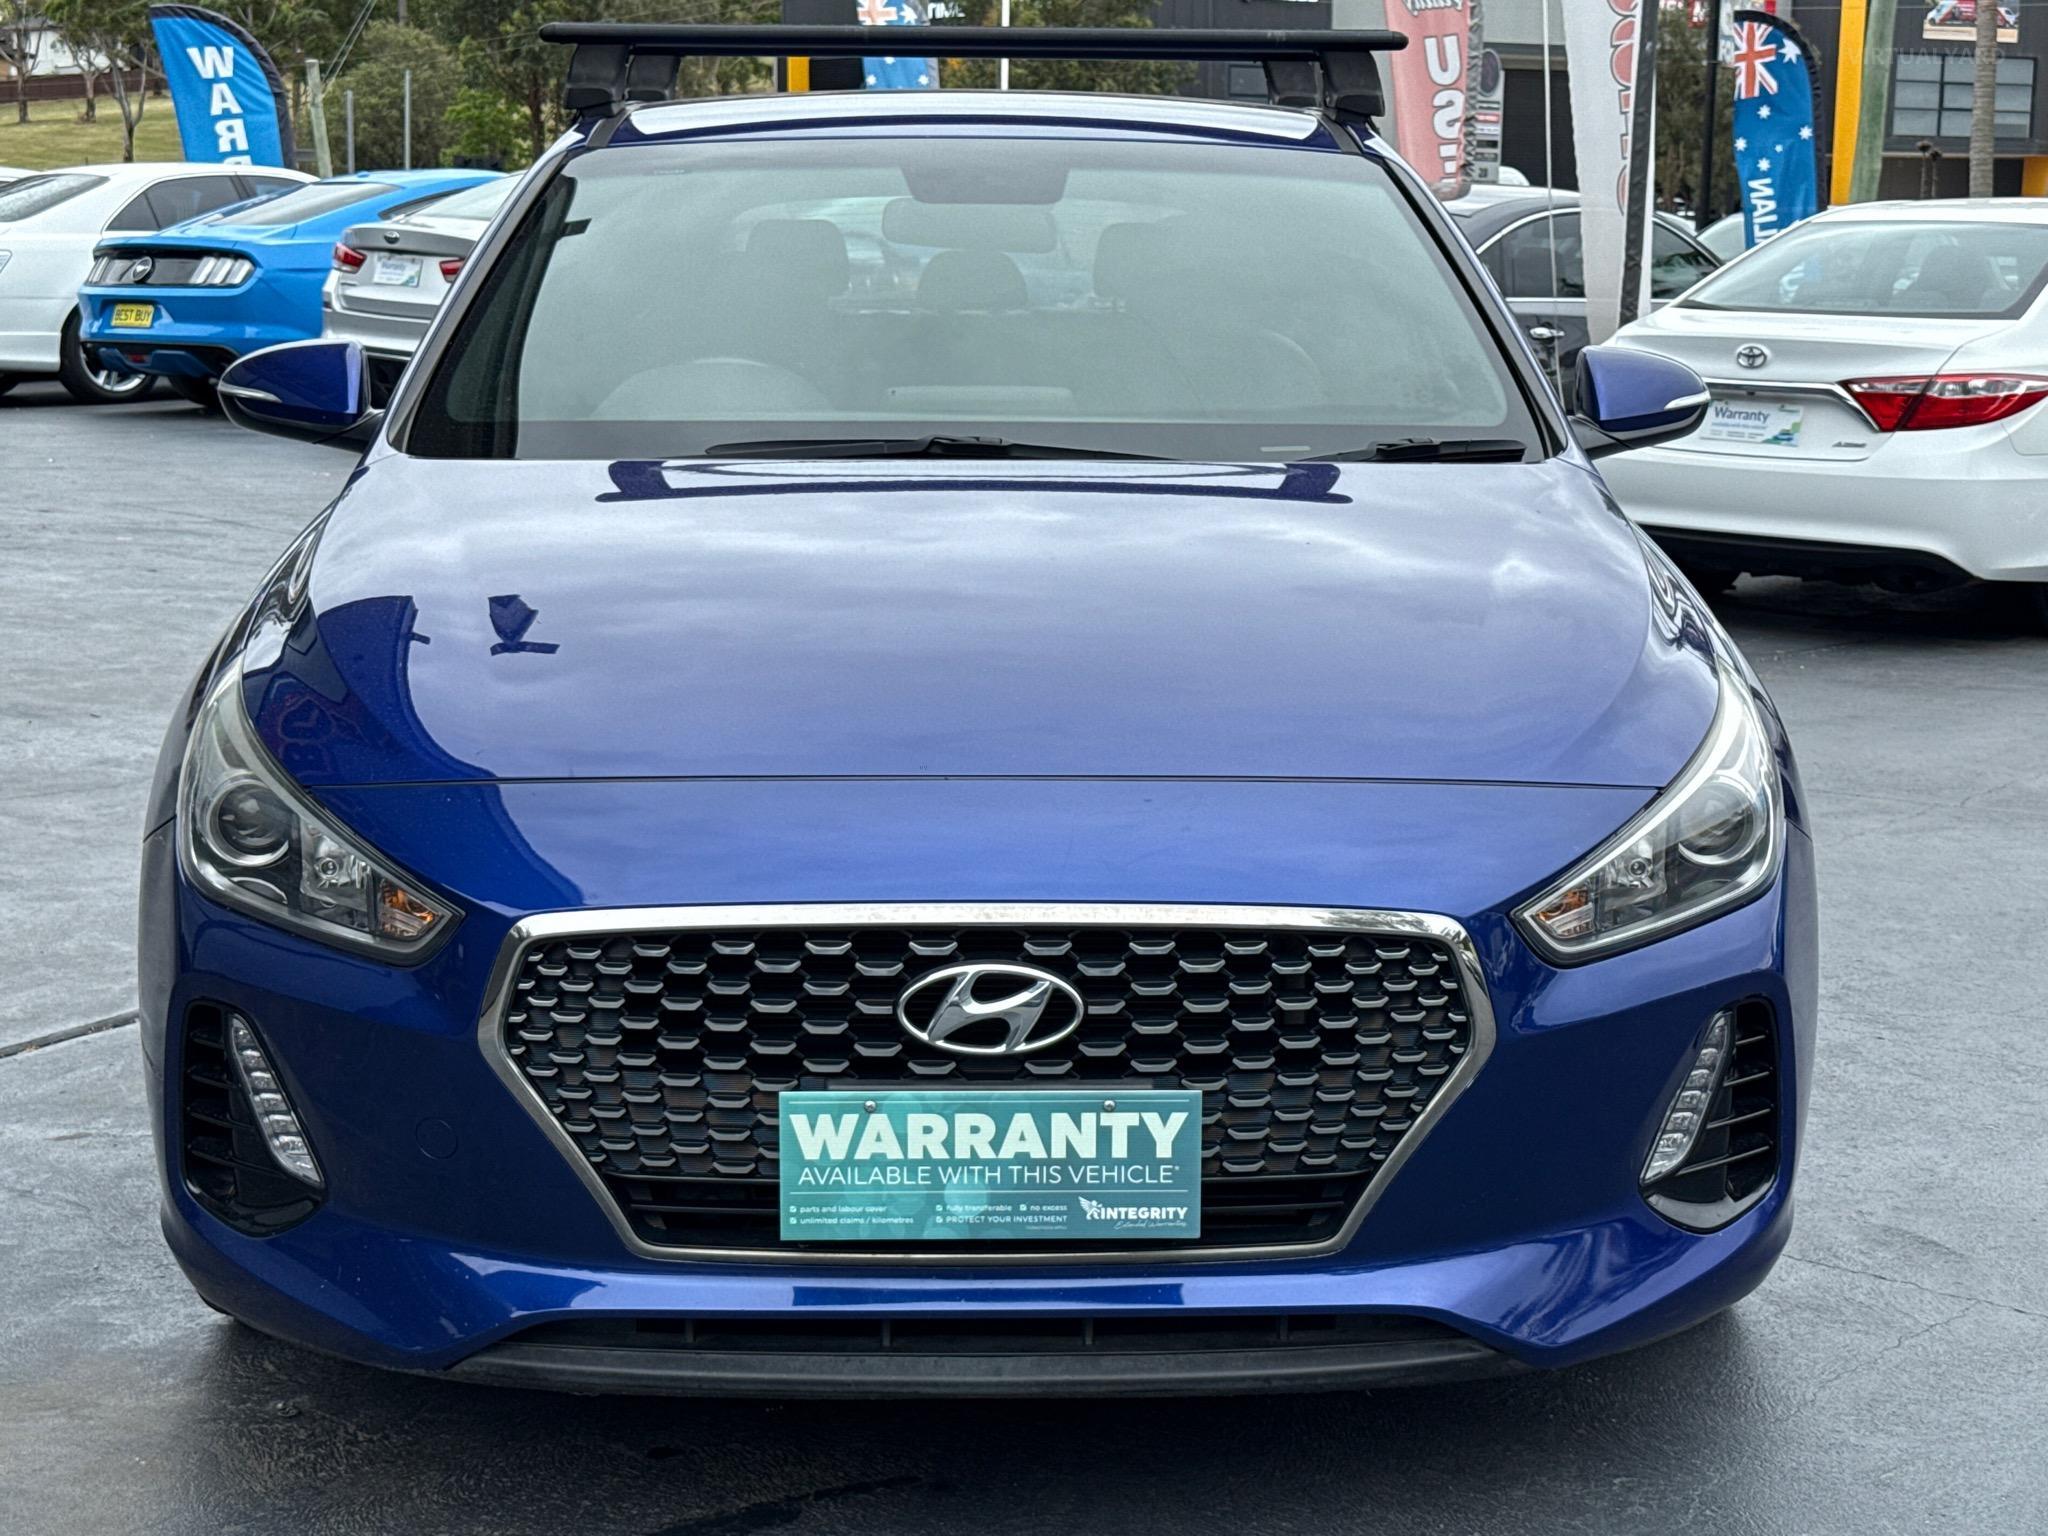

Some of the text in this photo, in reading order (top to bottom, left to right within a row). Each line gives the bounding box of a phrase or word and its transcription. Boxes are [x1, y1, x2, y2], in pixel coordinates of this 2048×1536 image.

[115, 309, 151, 322] BEST BUY
[1714, 406, 1770, 423] Warranty
[789, 1112, 1189, 1160] WARRANTY
[798, 1166, 931, 1185] AVAILABLE
[938, 1166, 1000, 1185] WITH
[1008, 1165, 1062, 1184] THIS
[839, 1205, 863, 1213] labour
[946, 1204, 1012, 1212] fully transferable
[1101, 1207, 1188, 1219] INTEGRITY
[800, 1216, 838, 1224] unlimited
[840, 1216, 864, 1224] claims
[871, 1216, 914, 1224] kilometres
[946, 1215, 1067, 1223] PROTECT YOUR INVESTMENT
